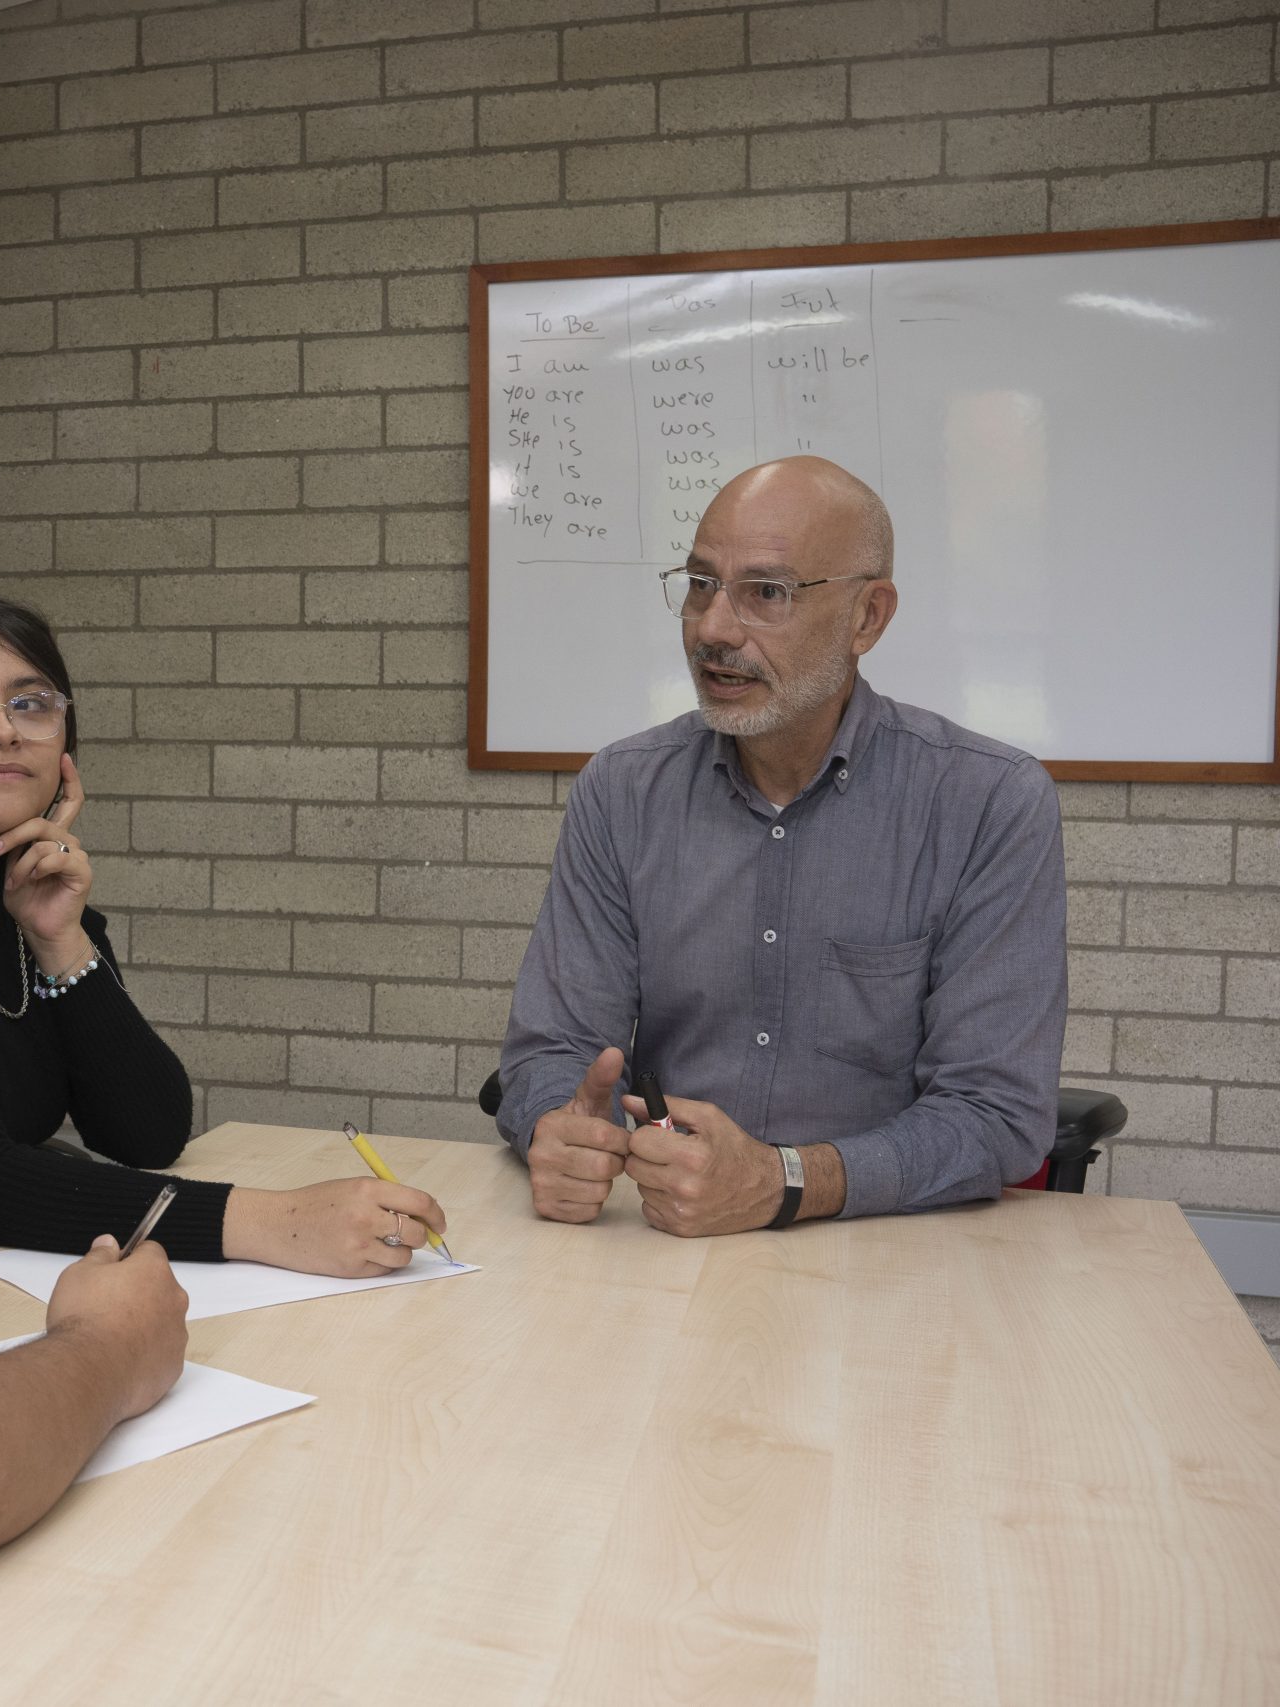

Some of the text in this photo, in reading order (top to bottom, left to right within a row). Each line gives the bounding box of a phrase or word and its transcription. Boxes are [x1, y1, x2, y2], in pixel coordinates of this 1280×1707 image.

[524, 311, 600, 335] To Be
[506, 353, 523, 373] I
[651, 355, 705, 375] was
[767, 346, 870, 373] will be
[545, 389, 584, 404] are
[652, 391, 714, 409] were
[508, 407, 530, 426] He
[660, 420, 716, 439] was
[665, 449, 720, 470] was
[563, 491, 603, 510] are
[507, 502, 608, 541] They are
